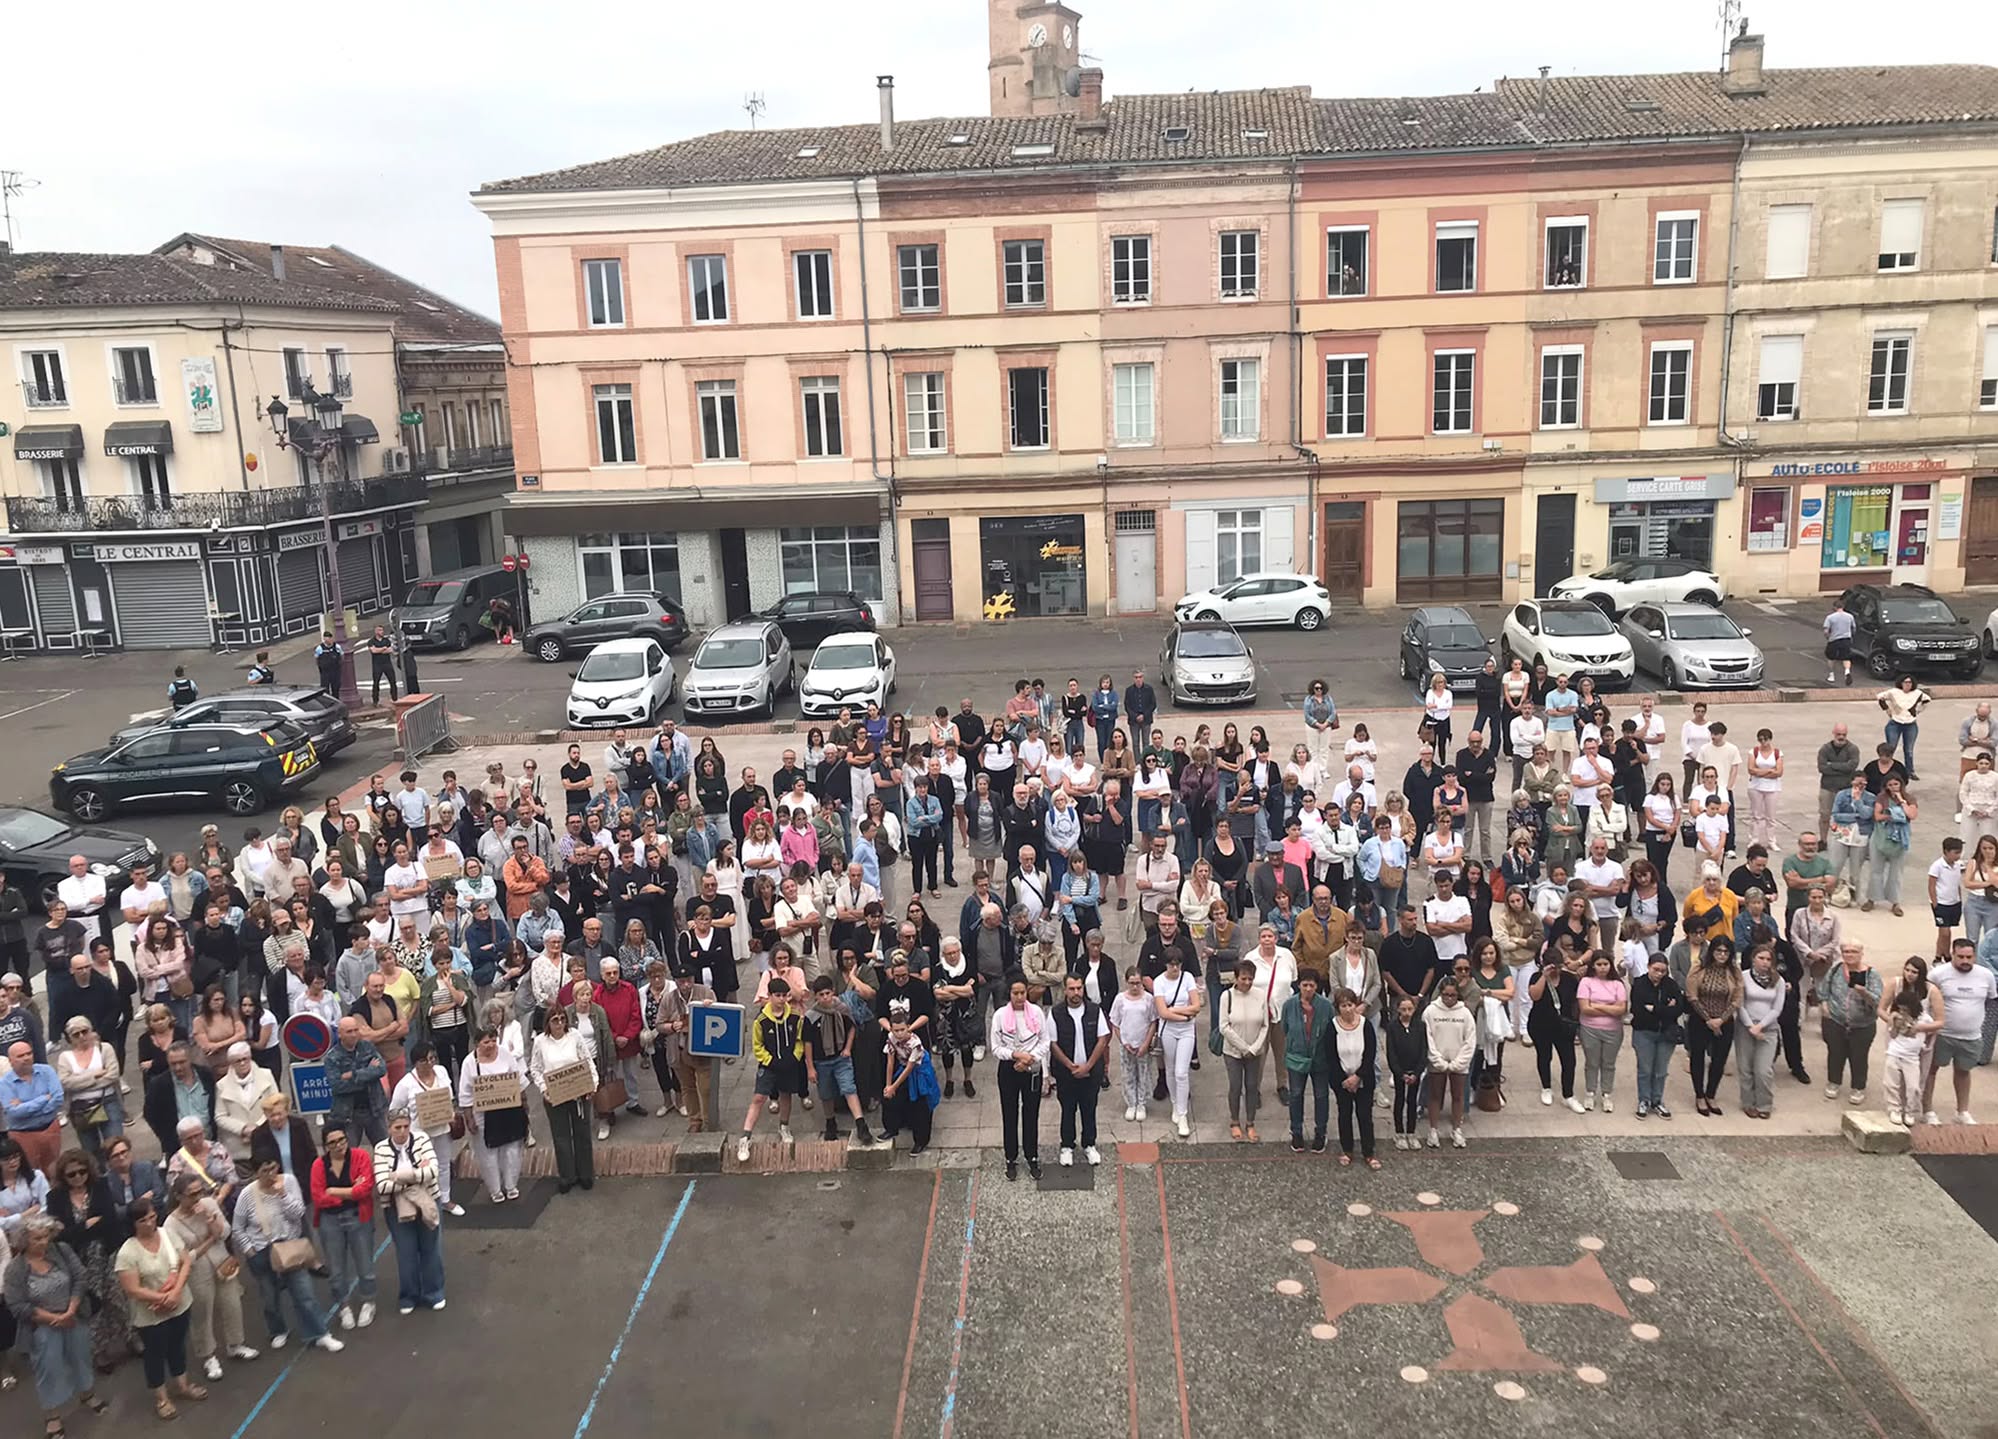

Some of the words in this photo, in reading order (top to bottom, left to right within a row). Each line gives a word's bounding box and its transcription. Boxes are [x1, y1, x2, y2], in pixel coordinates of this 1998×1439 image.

[18, 450, 65, 460] BRASSERIE
[106, 447, 117, 455] LE
[118, 445, 158, 456] CENTRAL
[1626, 481, 1658, 494] SERVICE
[1659, 481, 1683, 492] CARTE
[1684, 480, 1707, 492] GRISE
[1870, 488, 1891, 496] 2000
[281, 530, 327, 549] BRASSERIE
[96, 547, 117, 560] LE
[122, 545, 198, 559] CENTRAL
[704, 1015, 727, 1046] P
[302, 1088, 333, 1099] MINUT
